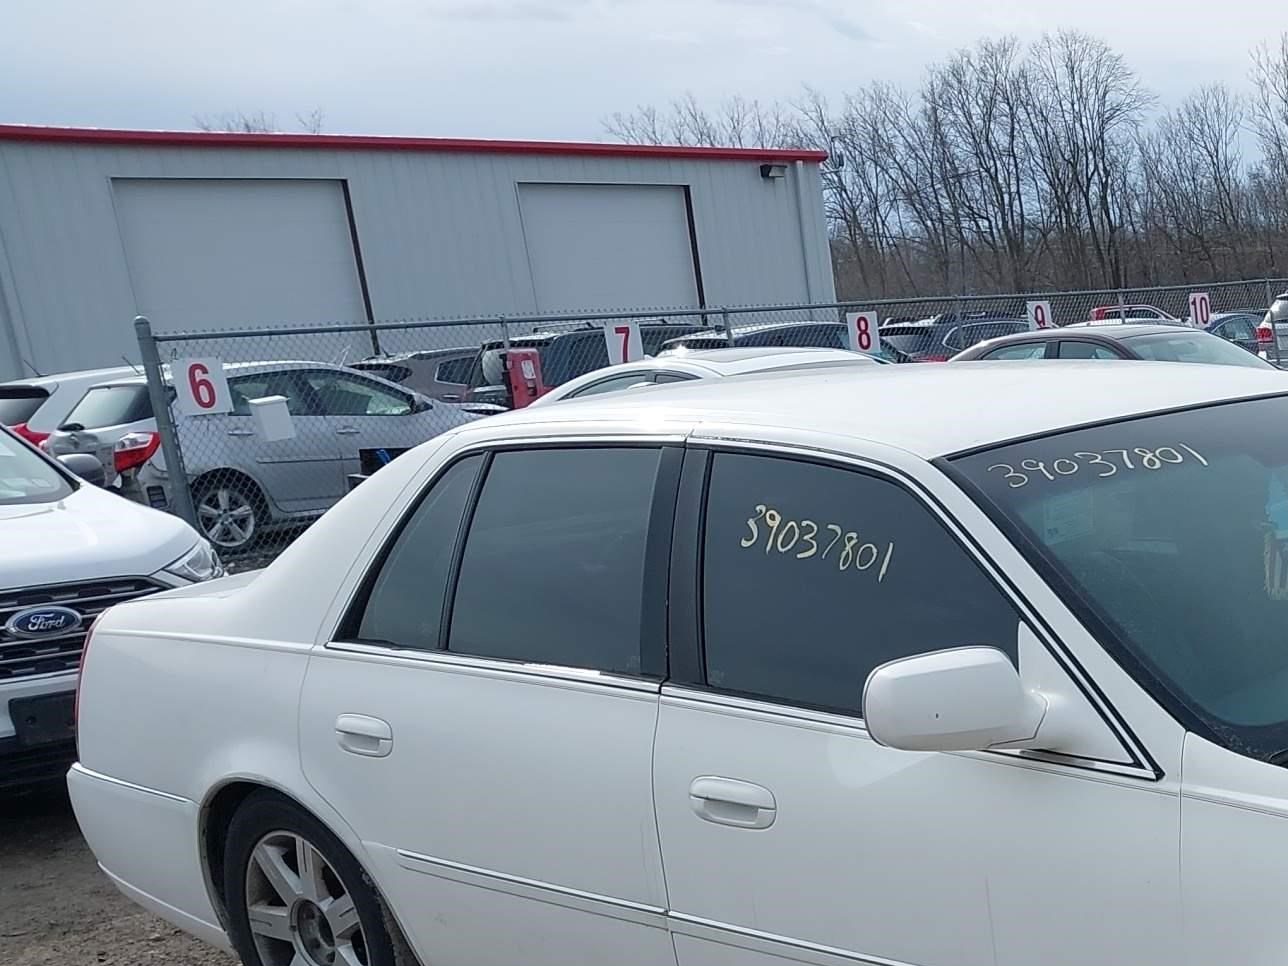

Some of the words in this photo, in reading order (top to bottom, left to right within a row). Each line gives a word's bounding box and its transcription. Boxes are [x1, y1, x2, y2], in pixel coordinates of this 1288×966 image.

[1034, 304, 1046, 328] 9
[1190, 296, 1209, 325] 10
[614, 326, 630, 363] 7
[856, 316, 871, 350] 8
[188, 363, 216, 409] 6
[987, 443, 1209, 488] 39037801
[27, 613, 65, 631] Ford
